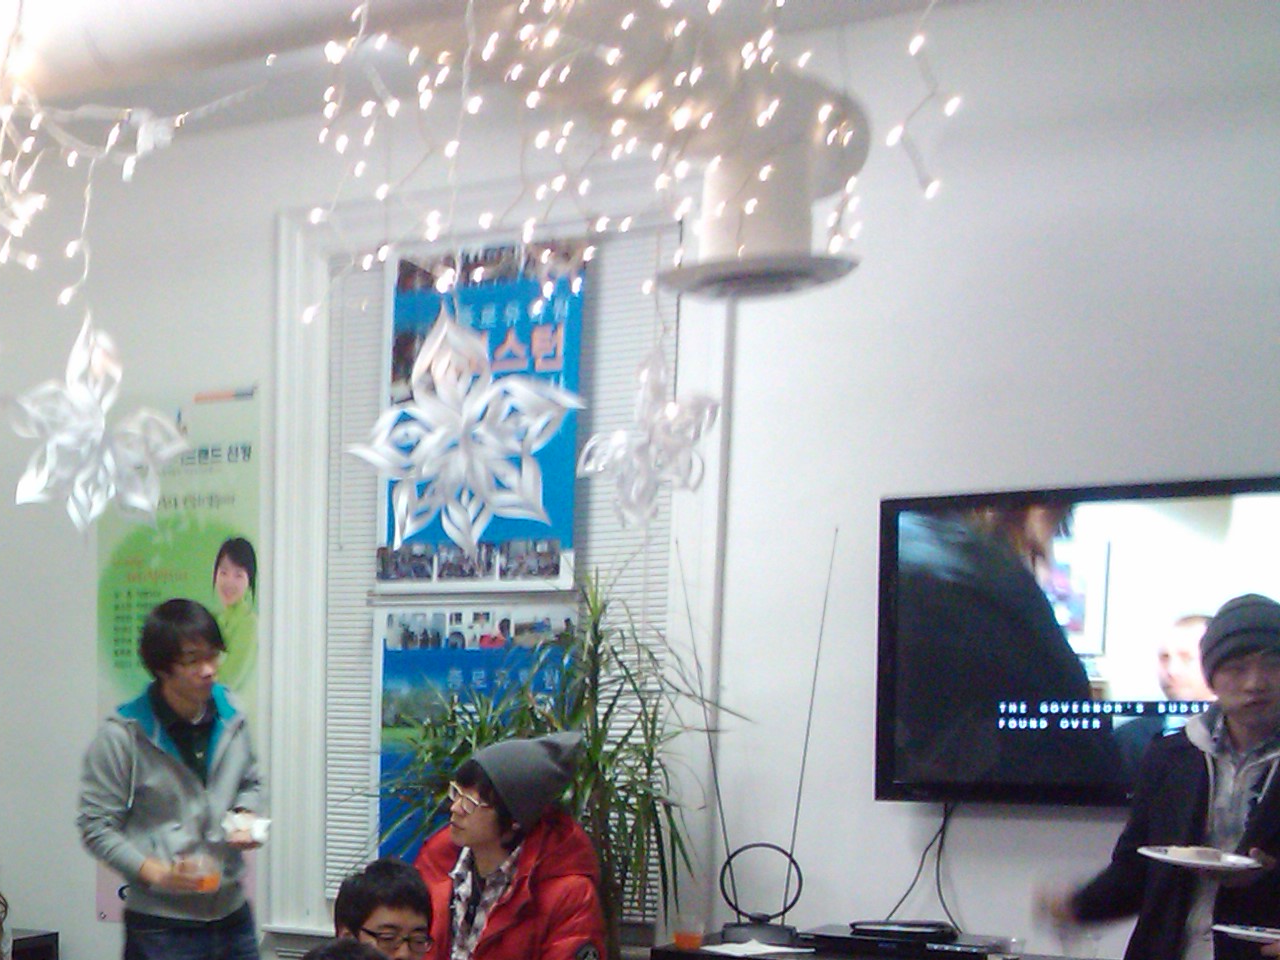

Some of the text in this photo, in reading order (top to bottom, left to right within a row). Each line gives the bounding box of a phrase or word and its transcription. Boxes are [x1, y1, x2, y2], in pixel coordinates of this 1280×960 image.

[998, 701, 1027, 714] THE
[1039, 701, 1144, 714] GOVERNOR'S
[997, 717, 1101, 729] FOUND OVER
